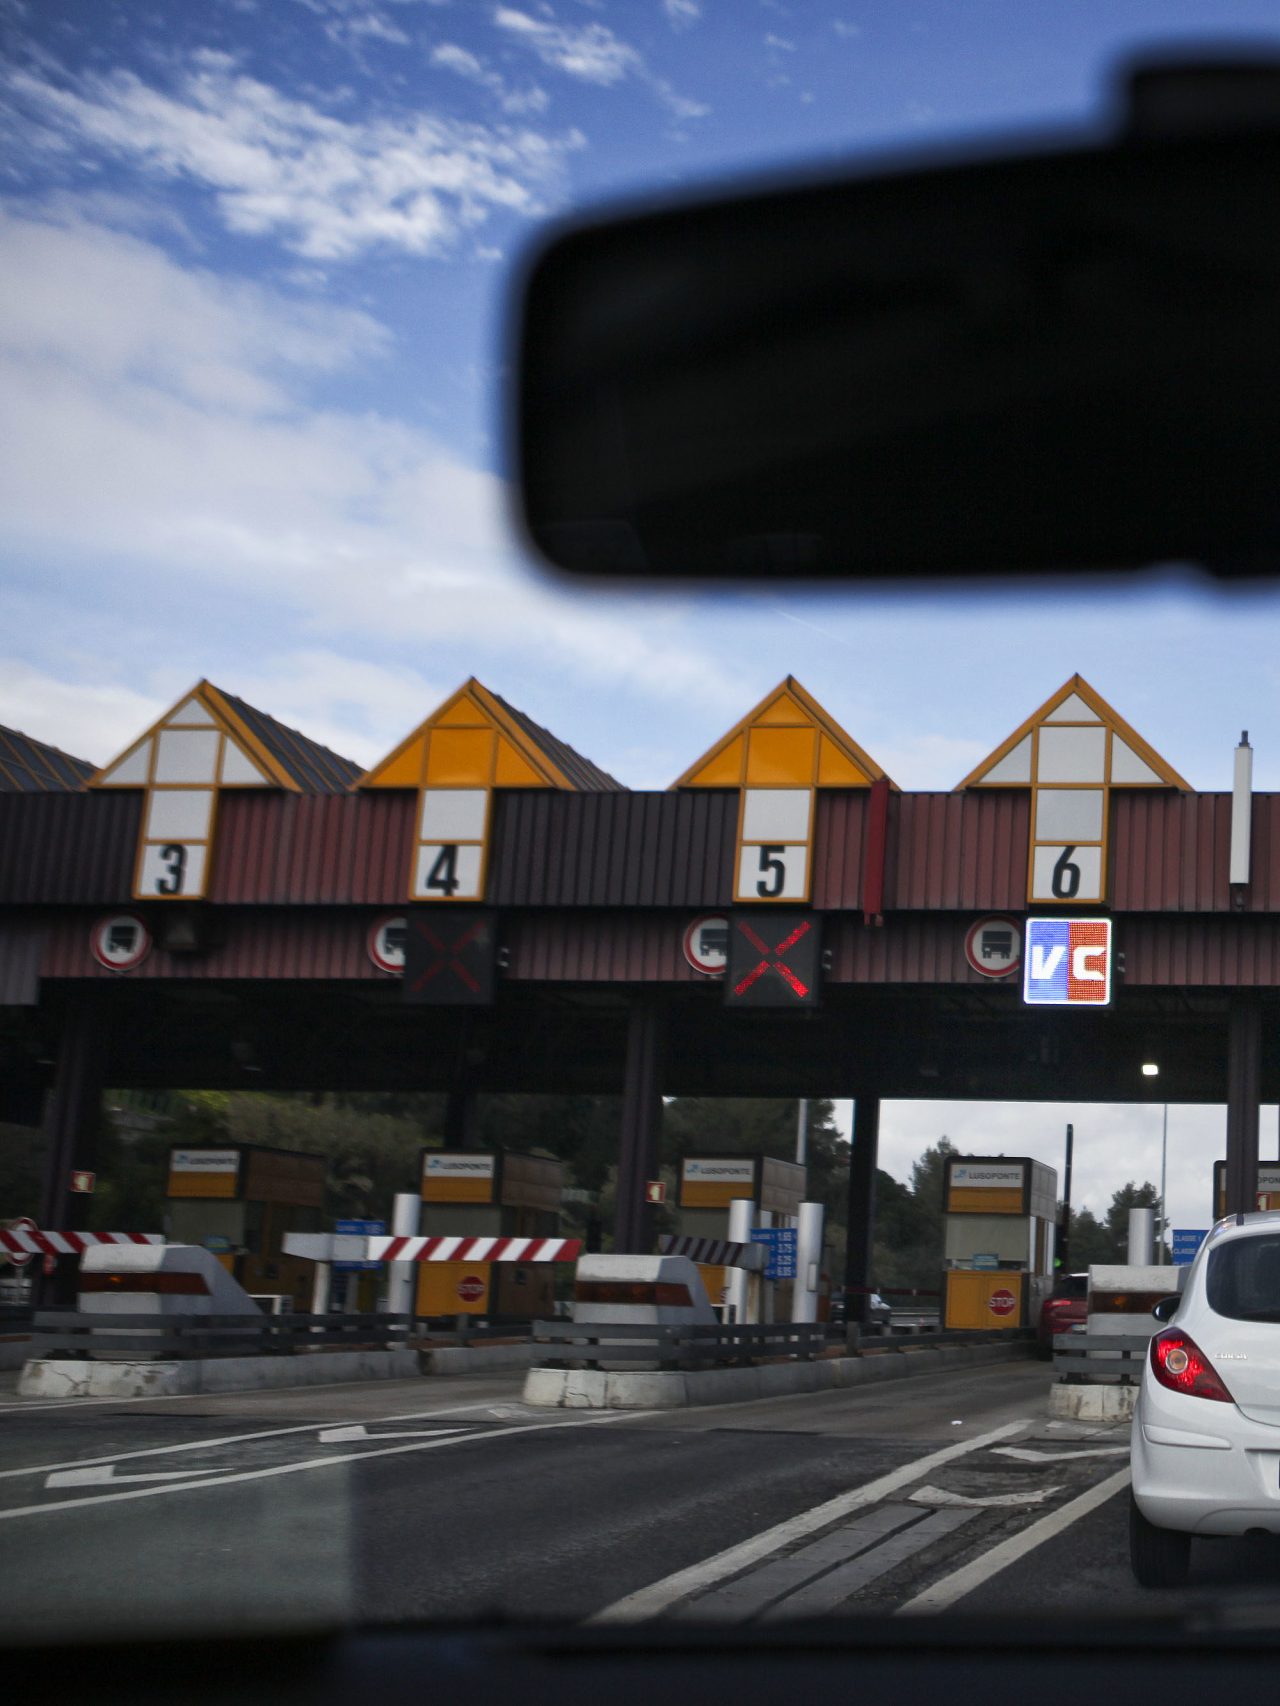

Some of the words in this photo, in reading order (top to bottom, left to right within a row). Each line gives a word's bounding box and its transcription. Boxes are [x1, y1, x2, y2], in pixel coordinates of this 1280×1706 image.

[158, 844, 186, 895] 3
[427, 844, 459, 895] 4
[757, 845, 785, 897] 5
[1052, 845, 1080, 898] 6
[989, 1297, 1015, 1307] STOP
